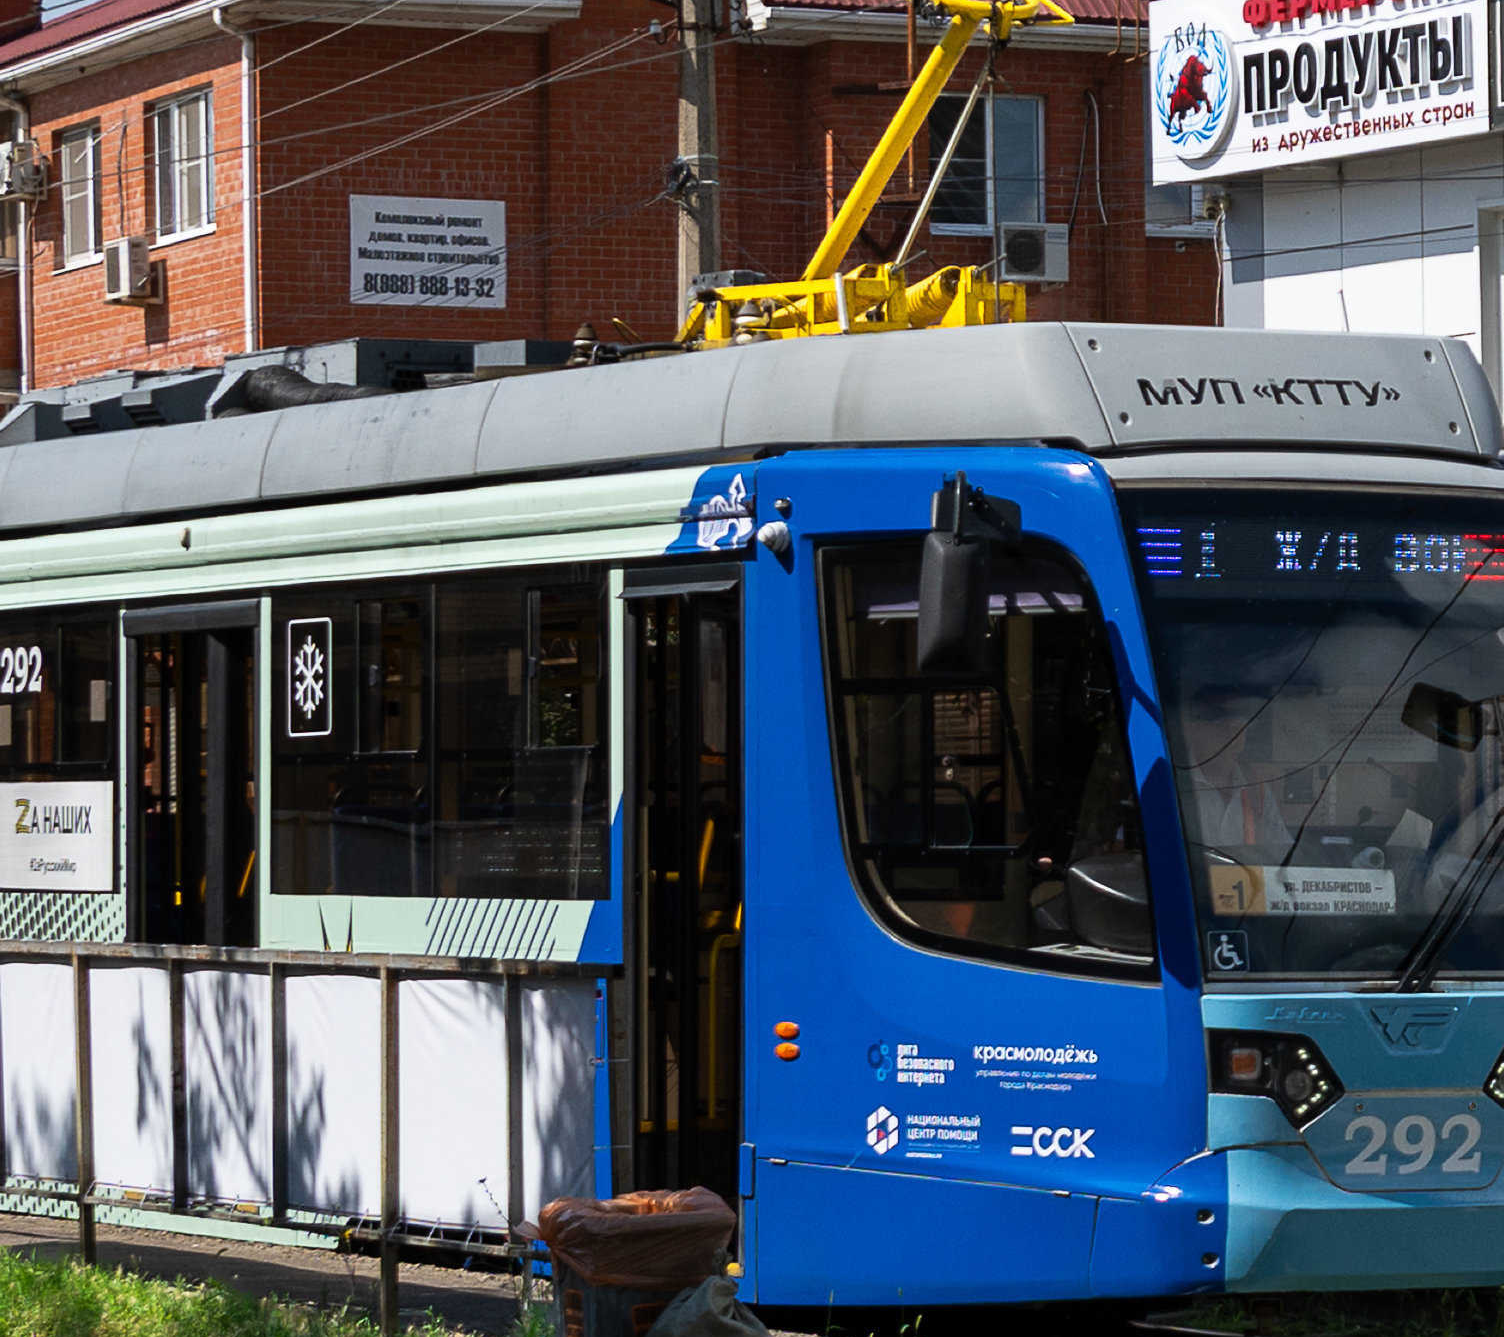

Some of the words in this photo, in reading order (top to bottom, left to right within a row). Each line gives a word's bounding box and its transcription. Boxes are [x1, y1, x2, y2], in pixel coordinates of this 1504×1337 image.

[1244, 15, 1463, 115] ПРОДУКТЫ
[1252, 136, 1269, 153] из
[1278, 112, 1415, 155] дружественных
[1422, 101, 1474, 125] стран
[1137, 377, 1246, 405] МУП
[1252, 377, 1400, 406] «КТТУ»
[0, 646, 42, 693] 292
[44, 806, 92, 833] НАШИХ
[1232, 880, 1244, 910] 1
[1302, 881, 1372, 893] ДЕКАБРИСТОВ
[974, 1045, 1098, 1064] красмолодёжь
[907, 1114, 981, 1127] НАЦИОНАЛЬНЫЙ
[908, 1129, 935, 1141] ЦЕНТР
[937, 1129, 978, 1142] ПОМОЩИ
[1345, 1115, 1481, 1175] 292
